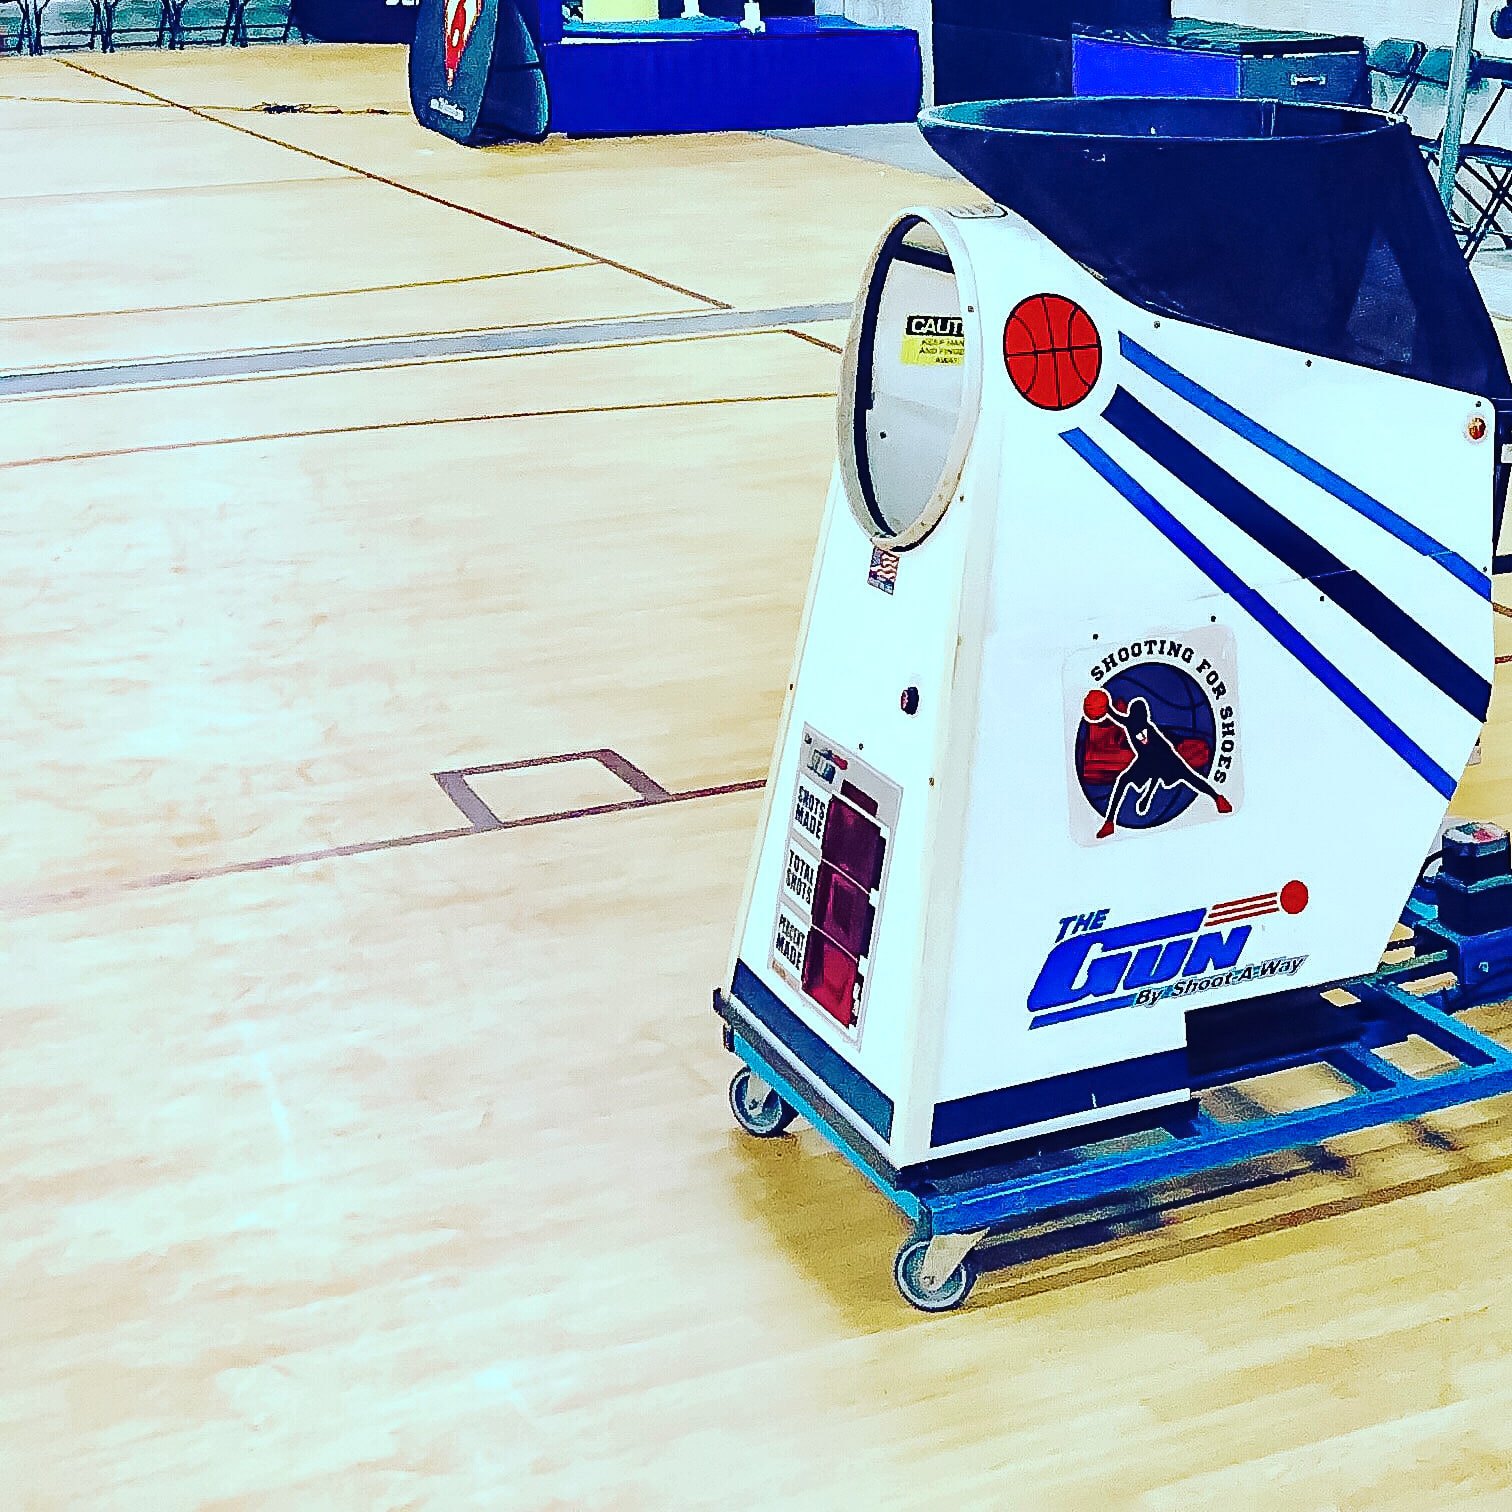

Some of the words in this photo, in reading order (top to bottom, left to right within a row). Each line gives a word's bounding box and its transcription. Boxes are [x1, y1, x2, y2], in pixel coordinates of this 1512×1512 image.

[911, 318, 964, 335] CAUT
[1090, 639, 1195, 682] SHOOTING
[1196, 658, 1227, 700] FOR
[1213, 705, 1236, 784] SHOES
[794, 803, 823, 840] MADE
[798, 785, 826, 821] SHOTS
[785, 867, 813, 905] SHOTS
[789, 848, 815, 887] TOTAL
[1055, 908, 1111, 943] THE
[775, 932, 802, 970] MADE
[1026, 907, 1252, 1013] GUN
[1134, 987, 1164, 1006] By
[1172, 956, 1308, 997] Shoot-A-Way
